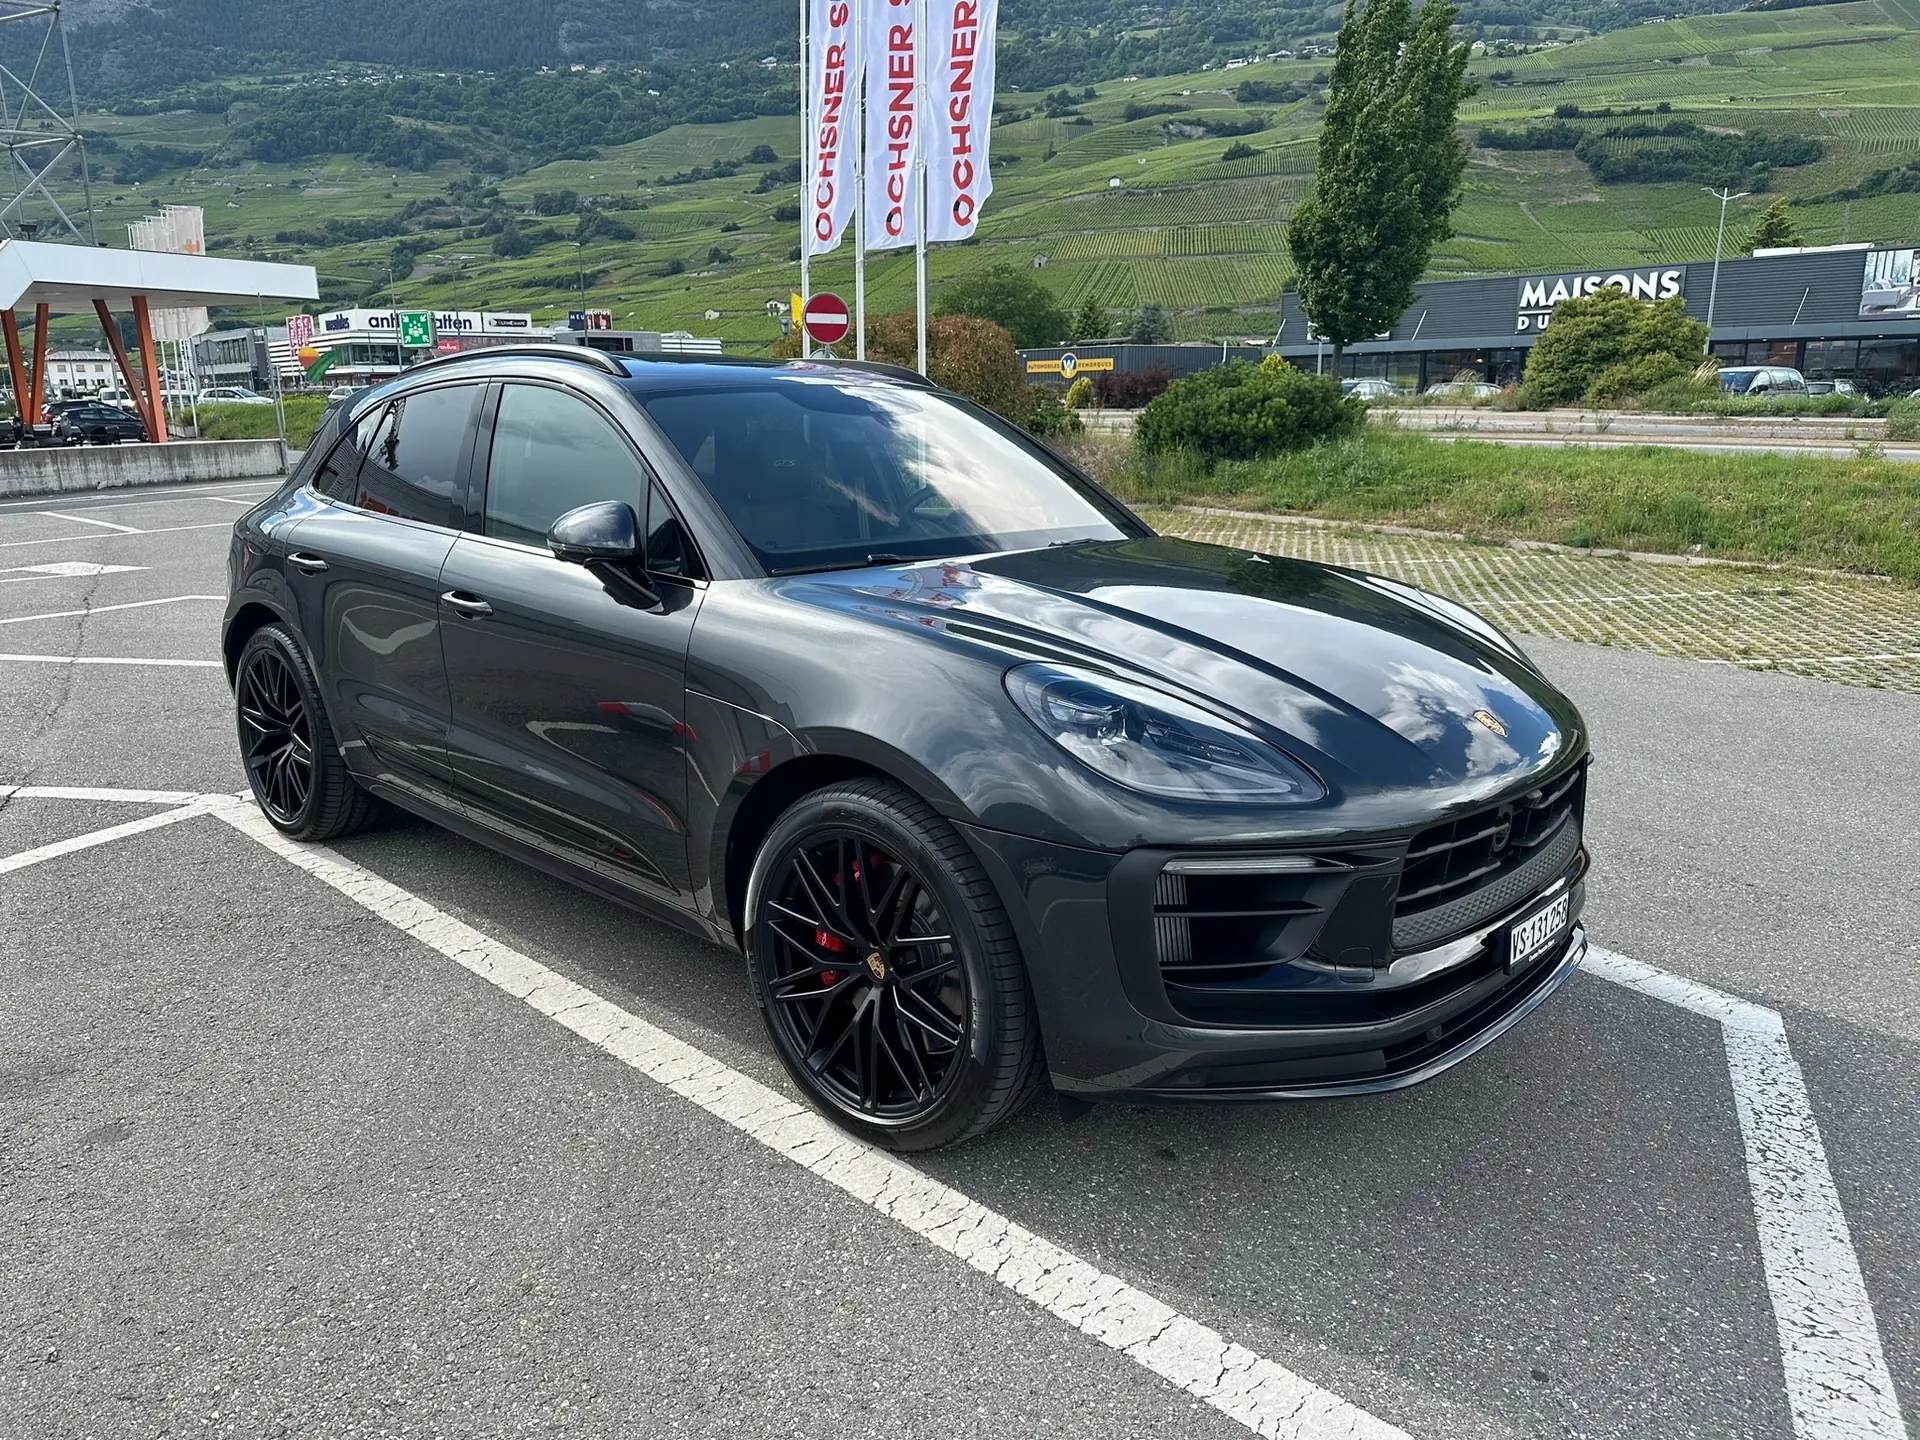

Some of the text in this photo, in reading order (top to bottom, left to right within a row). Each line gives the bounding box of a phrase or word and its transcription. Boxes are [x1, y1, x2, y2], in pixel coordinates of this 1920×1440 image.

[816, 0, 849, 241] OCHSNER S
[886, 23, 914, 236] OCHSNER
[950, 0, 978, 226] OCHSNER
